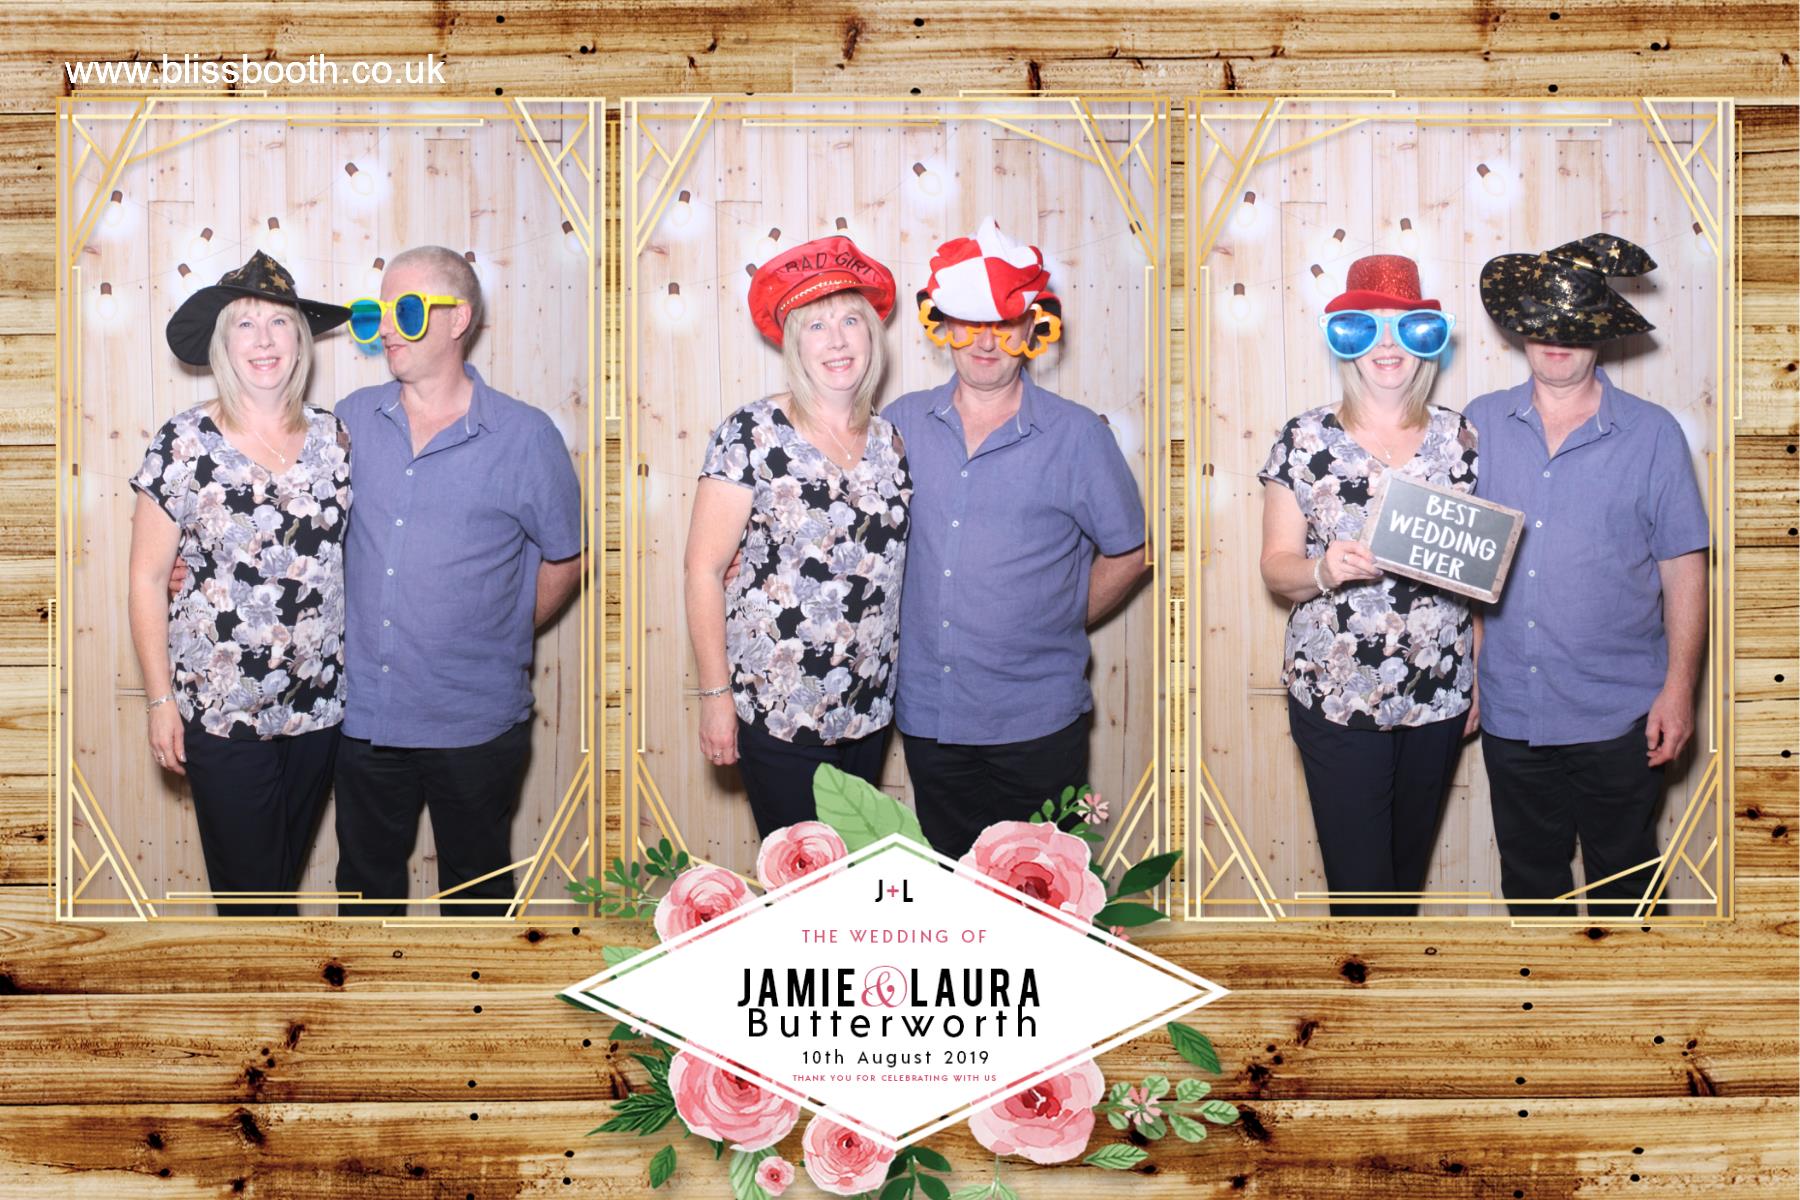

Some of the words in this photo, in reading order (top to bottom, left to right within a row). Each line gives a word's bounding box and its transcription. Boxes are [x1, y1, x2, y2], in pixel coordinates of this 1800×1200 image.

[785, 252, 827, 273] BAD
[1426, 494, 1481, 528] BEST
[1389, 509, 1497, 561] WEDDING
[1409, 545, 1465, 580] EVER
